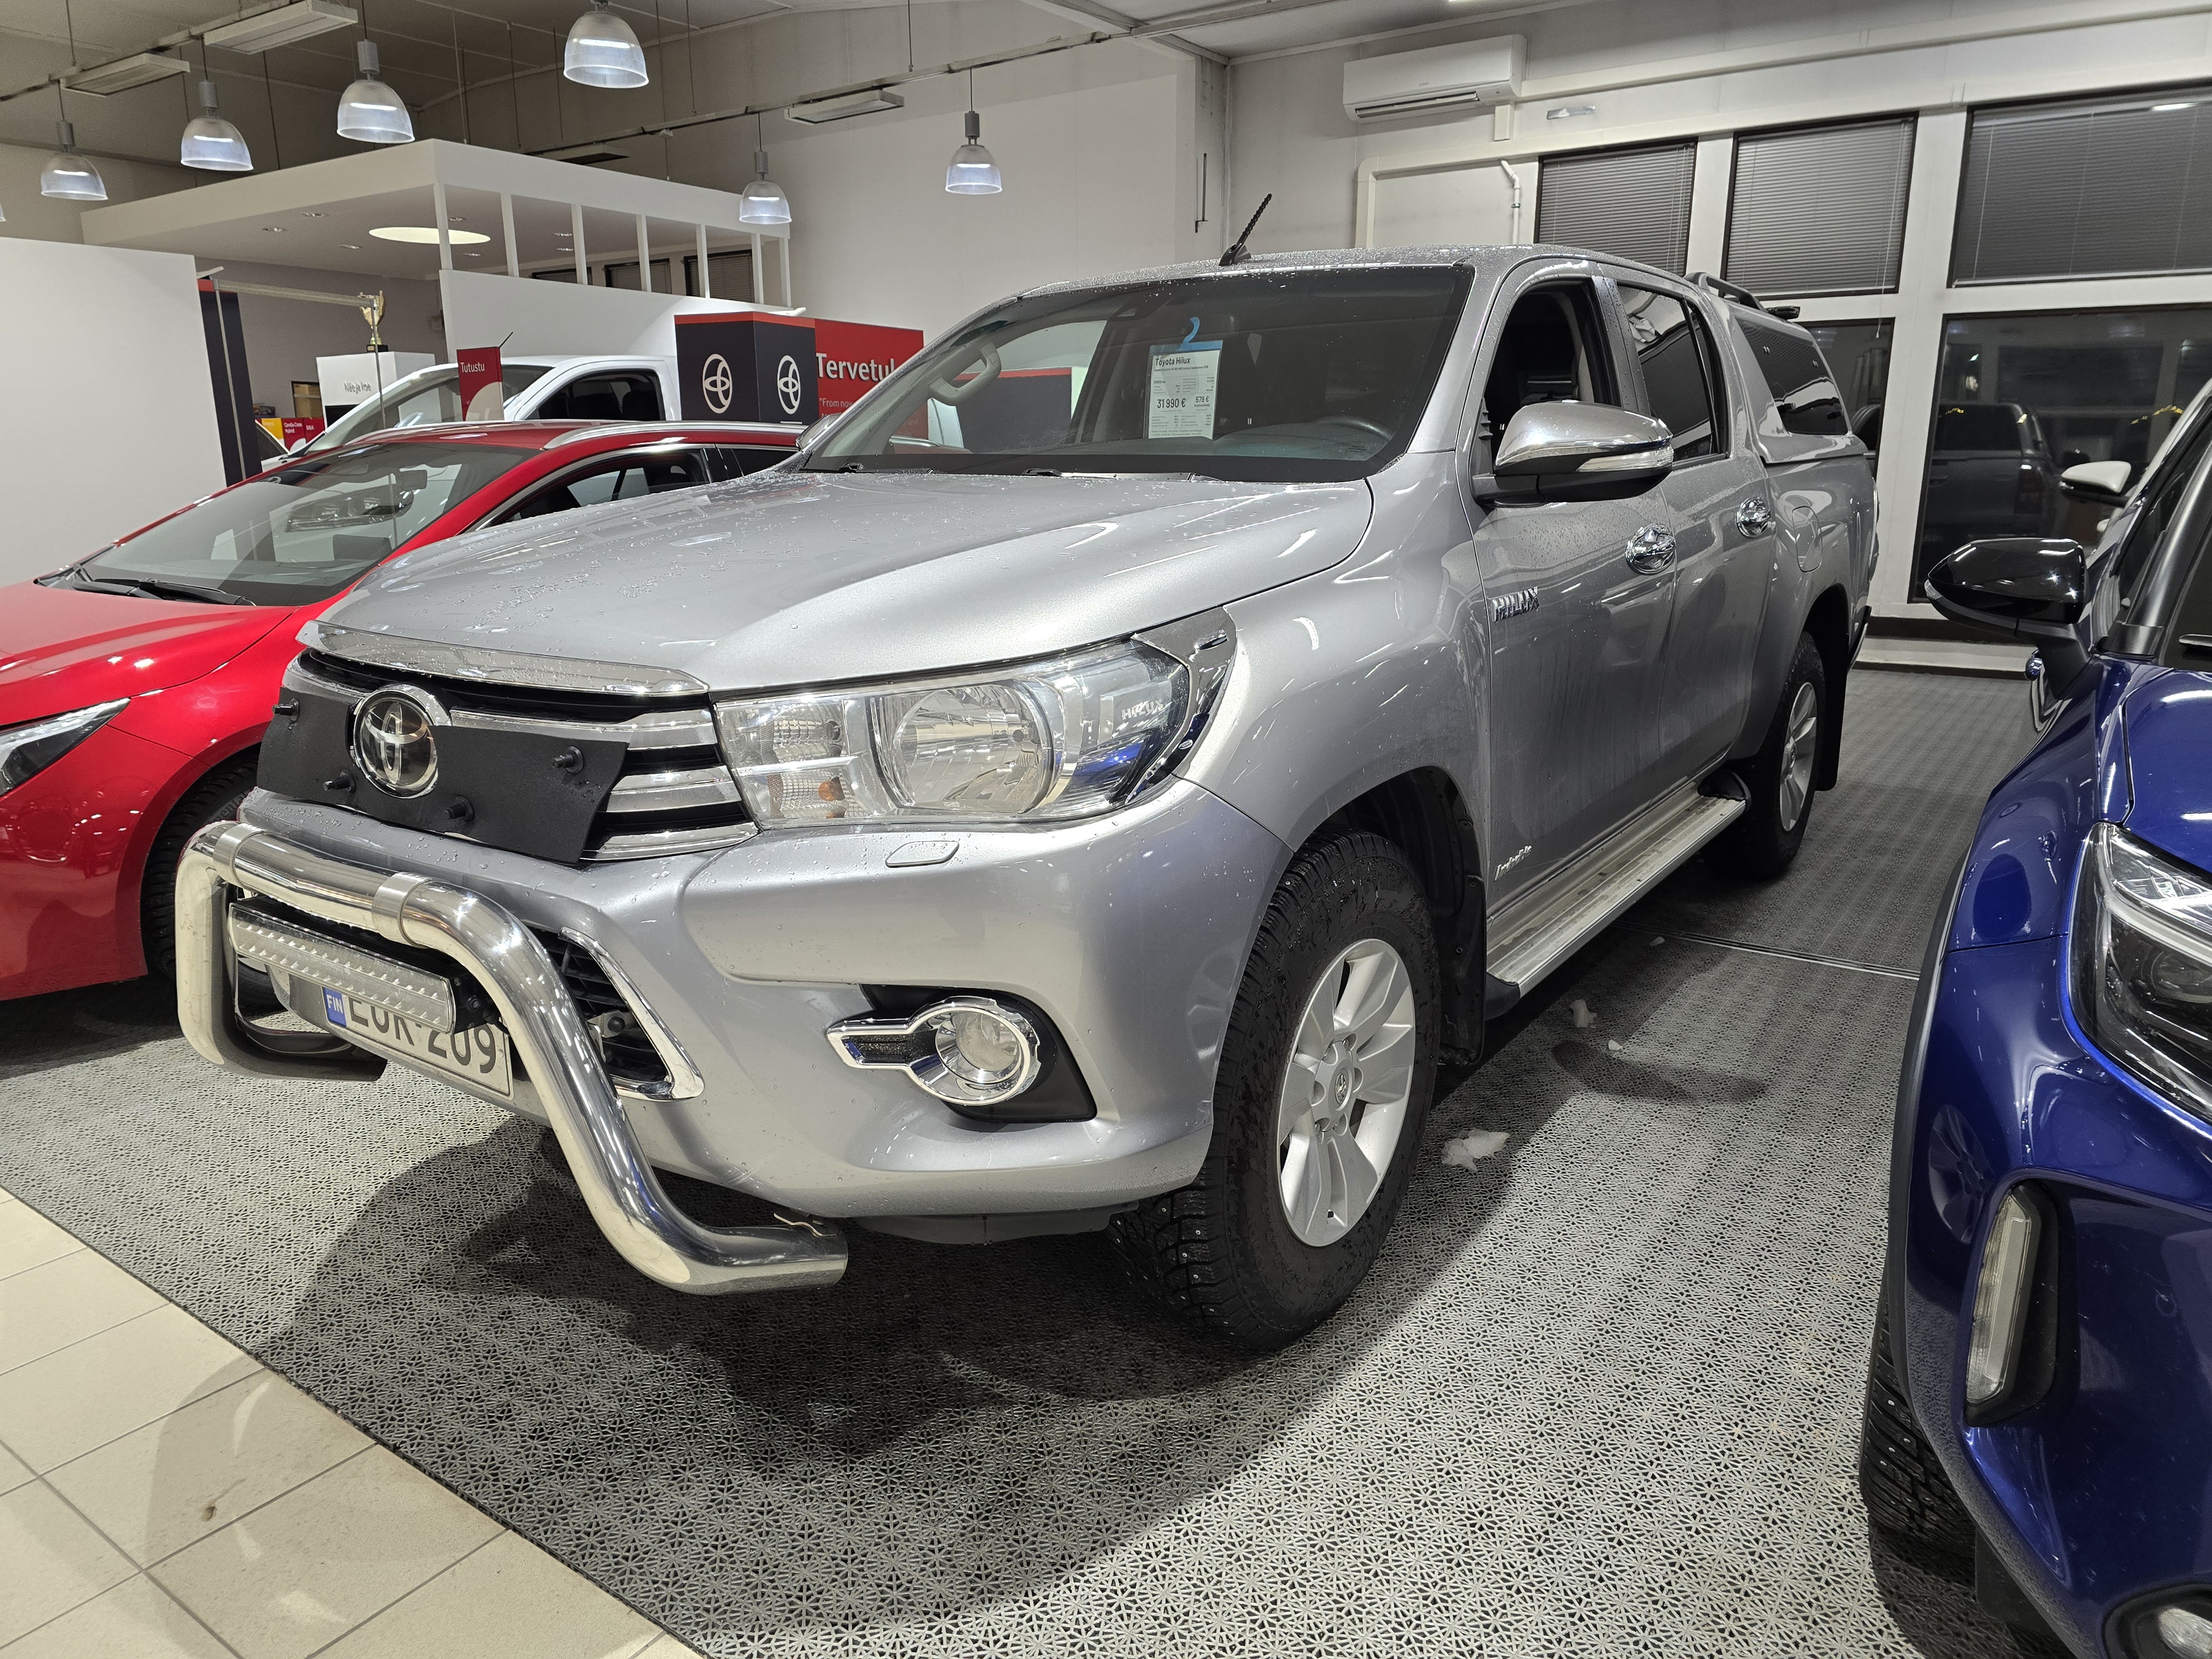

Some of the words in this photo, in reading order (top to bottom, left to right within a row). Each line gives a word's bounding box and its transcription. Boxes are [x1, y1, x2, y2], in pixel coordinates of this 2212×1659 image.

[460, 362, 485, 373] Tutustu
[1156, 358, 1175, 367] Toyota
[819, 398, 839, 407] "From
[1181, 398, 1186, 408] €
[1491, 586, 1540, 623] HILUX
[326, 994, 343, 1014] FIN
